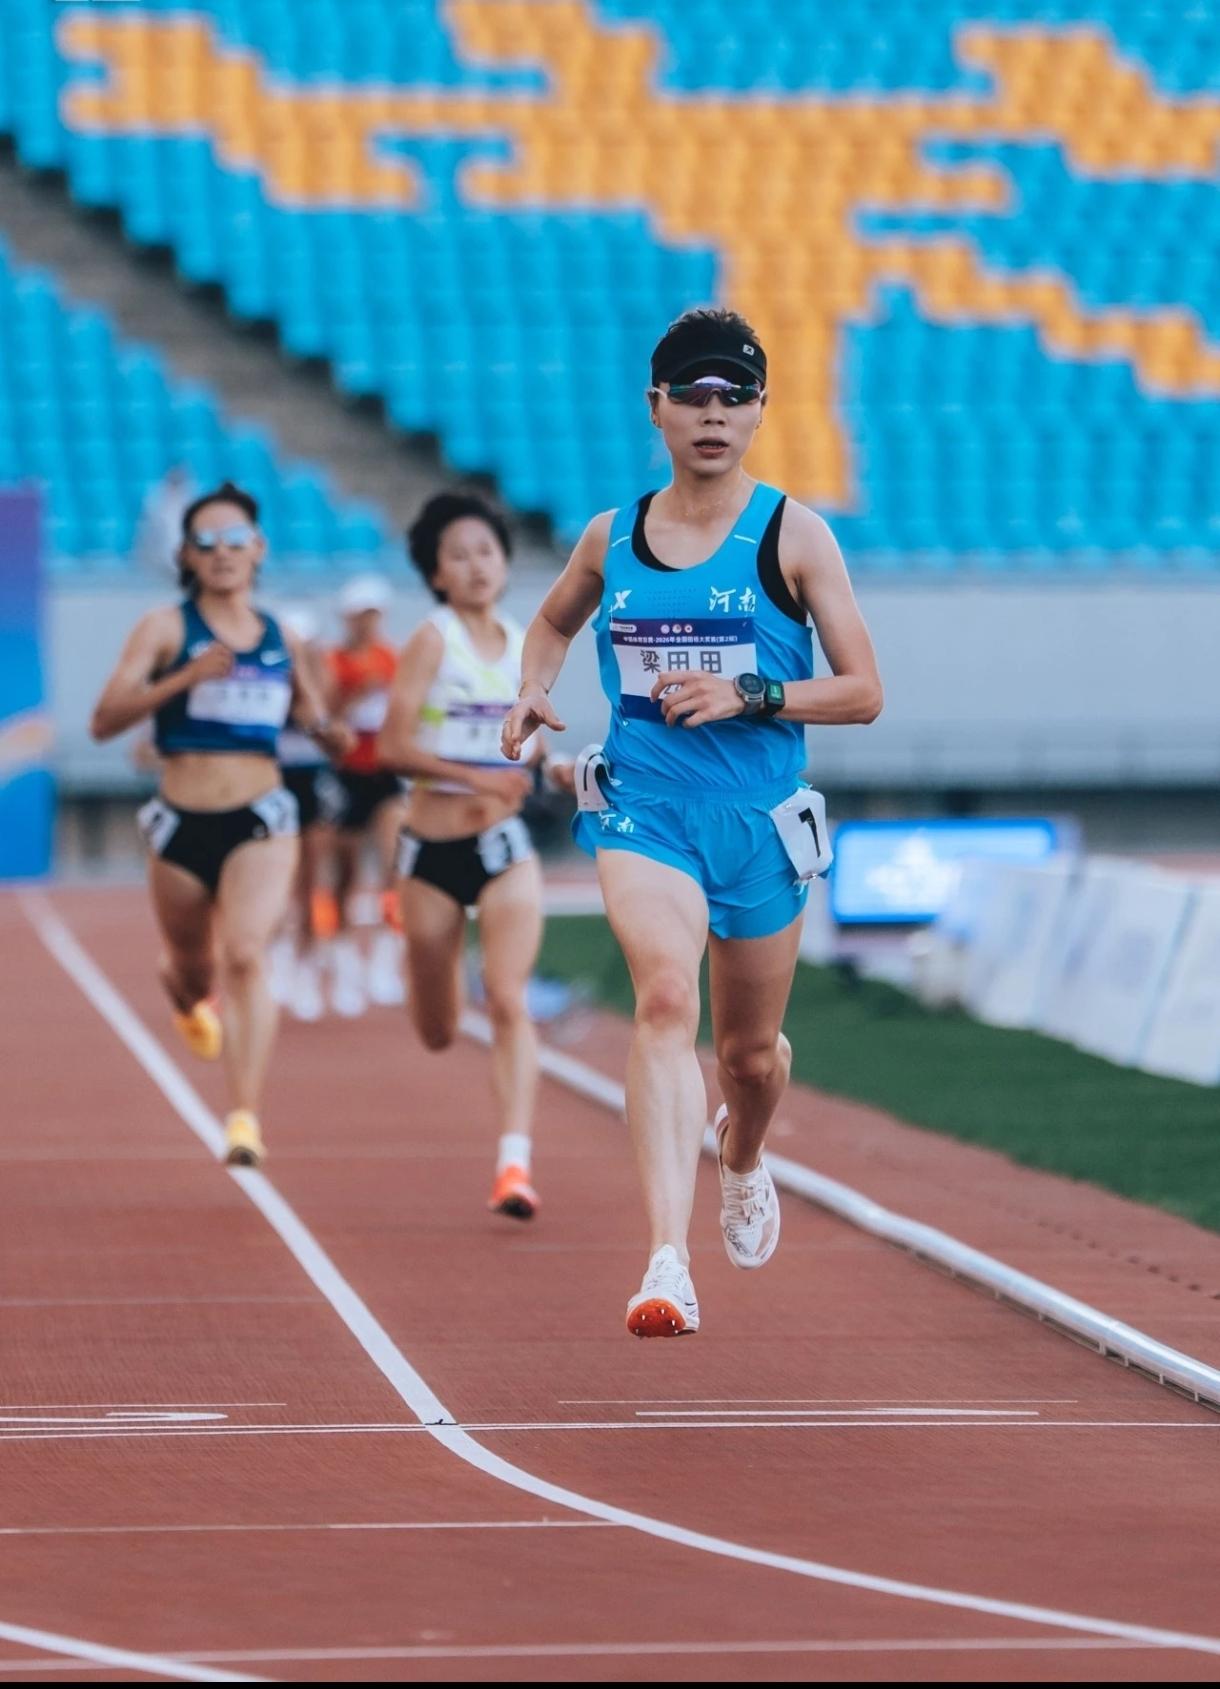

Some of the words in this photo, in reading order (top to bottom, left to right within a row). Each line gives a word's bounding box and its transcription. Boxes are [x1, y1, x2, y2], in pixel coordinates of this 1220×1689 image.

[708, 586, 756, 613] 河南
[640, 650, 722, 674] 梁田田
